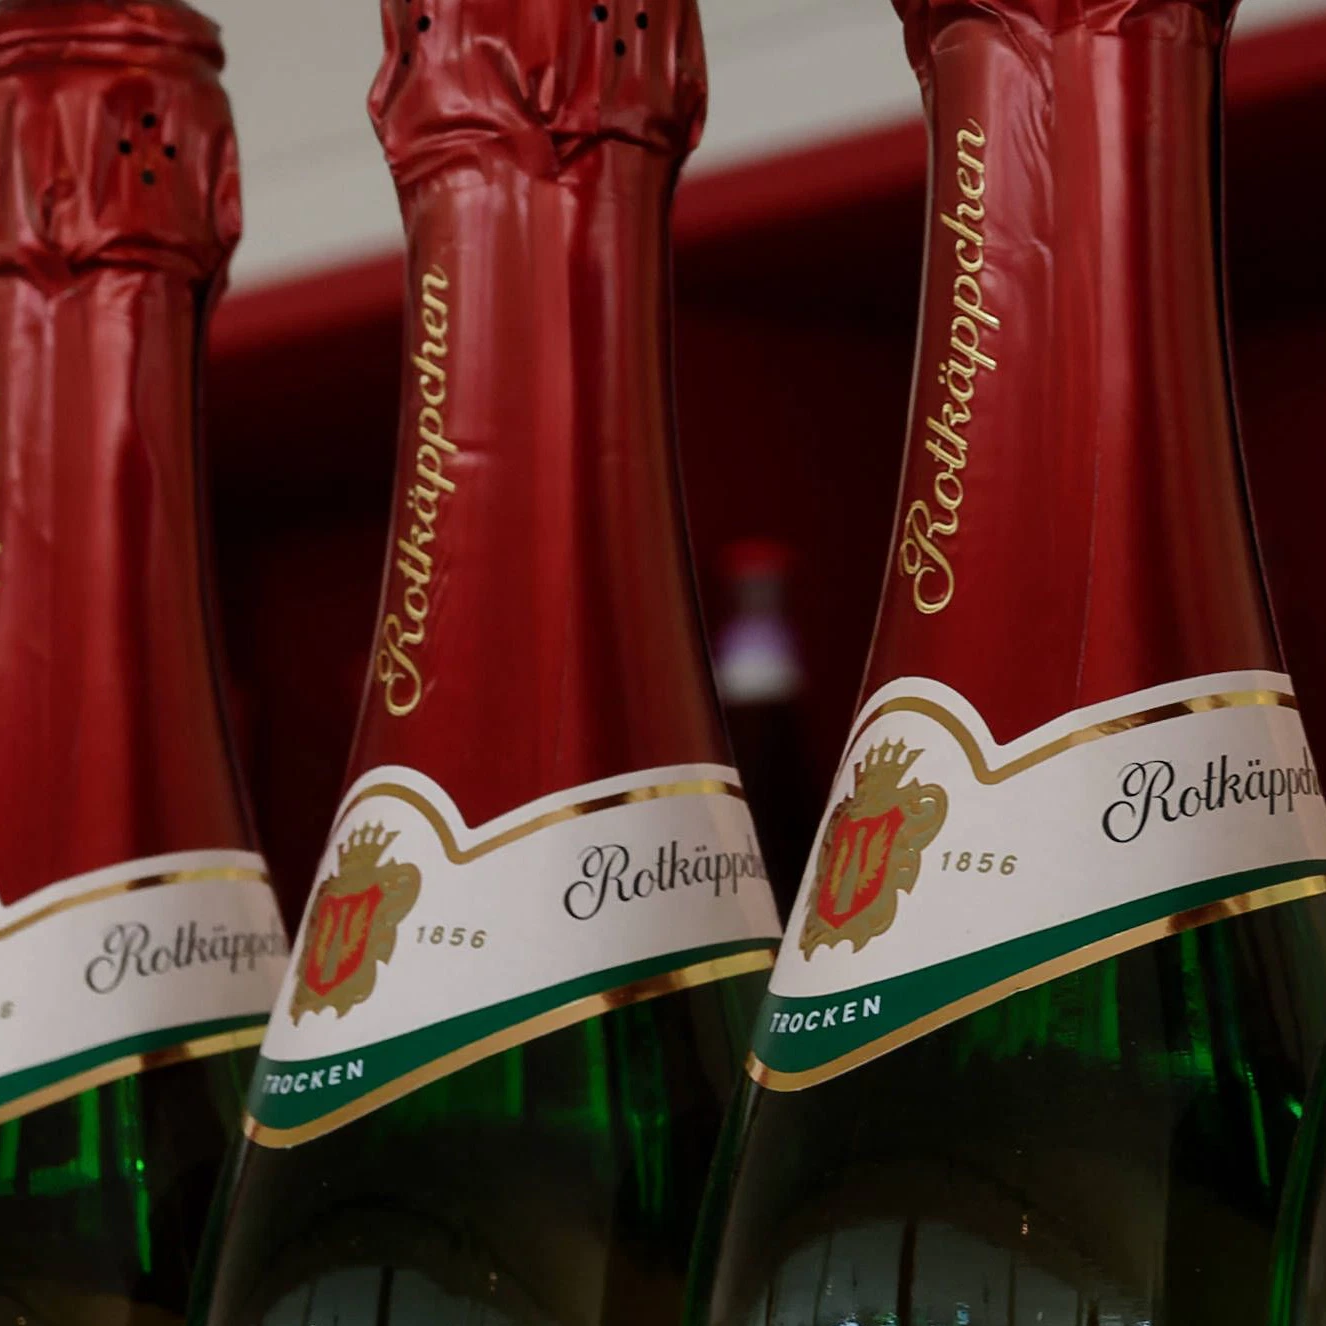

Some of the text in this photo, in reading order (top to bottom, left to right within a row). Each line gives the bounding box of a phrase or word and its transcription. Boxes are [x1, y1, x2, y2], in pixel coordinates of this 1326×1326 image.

[899, 118, 1001, 615] Rotkäppchen
[375, 264, 459, 716] Rotkäppchen
[941, 851, 1019, 876] 1856
[414, 925, 488, 949] 1856
[768, 995, 882, 1035] TROCKEN
[262, 1058, 364, 1096] TROCKEN
